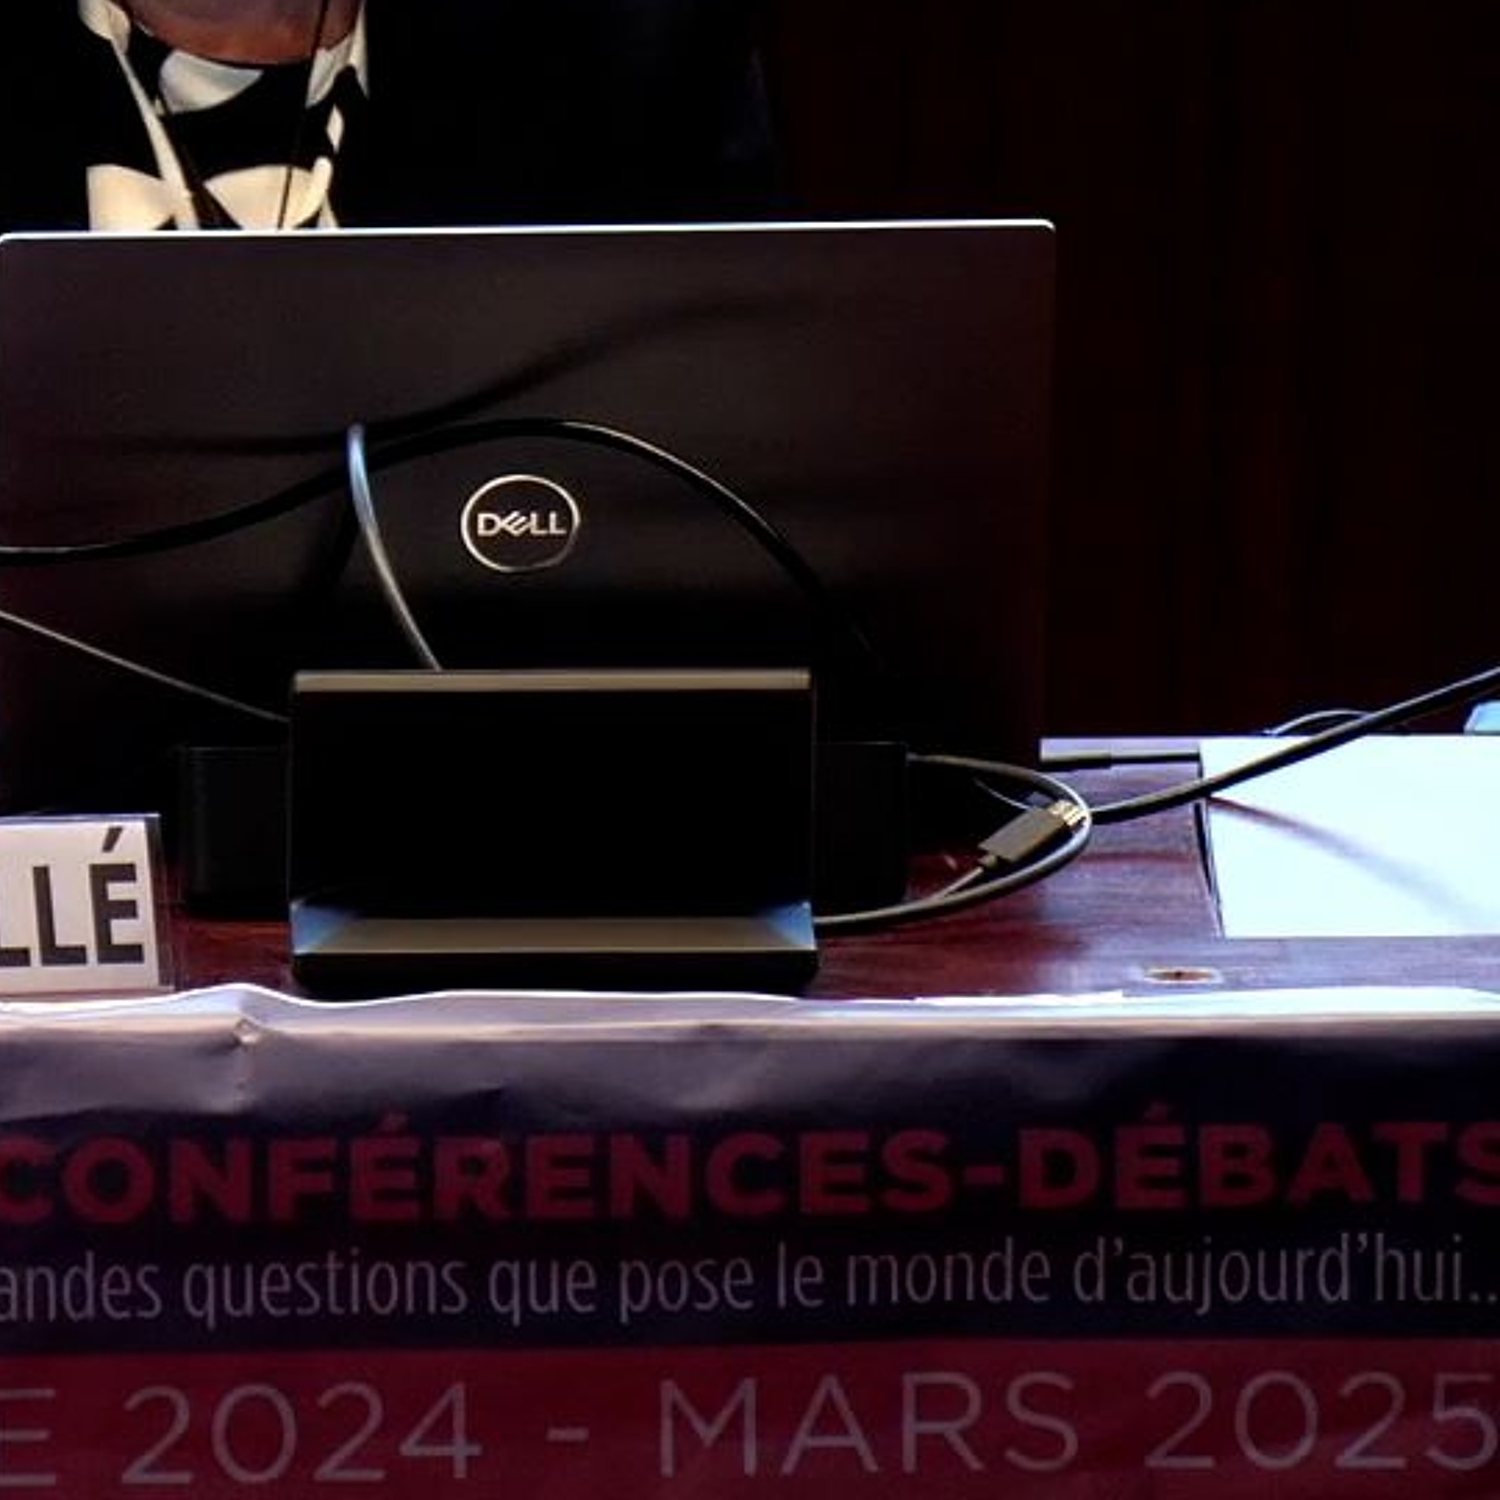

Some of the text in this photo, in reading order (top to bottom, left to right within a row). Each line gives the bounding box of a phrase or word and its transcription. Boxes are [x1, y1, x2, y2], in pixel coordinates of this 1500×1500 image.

[477, 511, 567, 536] DELL
[181, 1247, 469, 1330] questions
[487, 1257, 598, 1326] que
[619, 1256, 754, 1325] pose
[776, 1241, 825, 1308] le
[846, 1235, 1051, 1305] monde
[120, 1381, 483, 1485] 2024
[546, 1425, 590, 1443] -
[658, 1370, 1080, 1479] MARS
[1143, 1369, 1500, 1472] 2025
